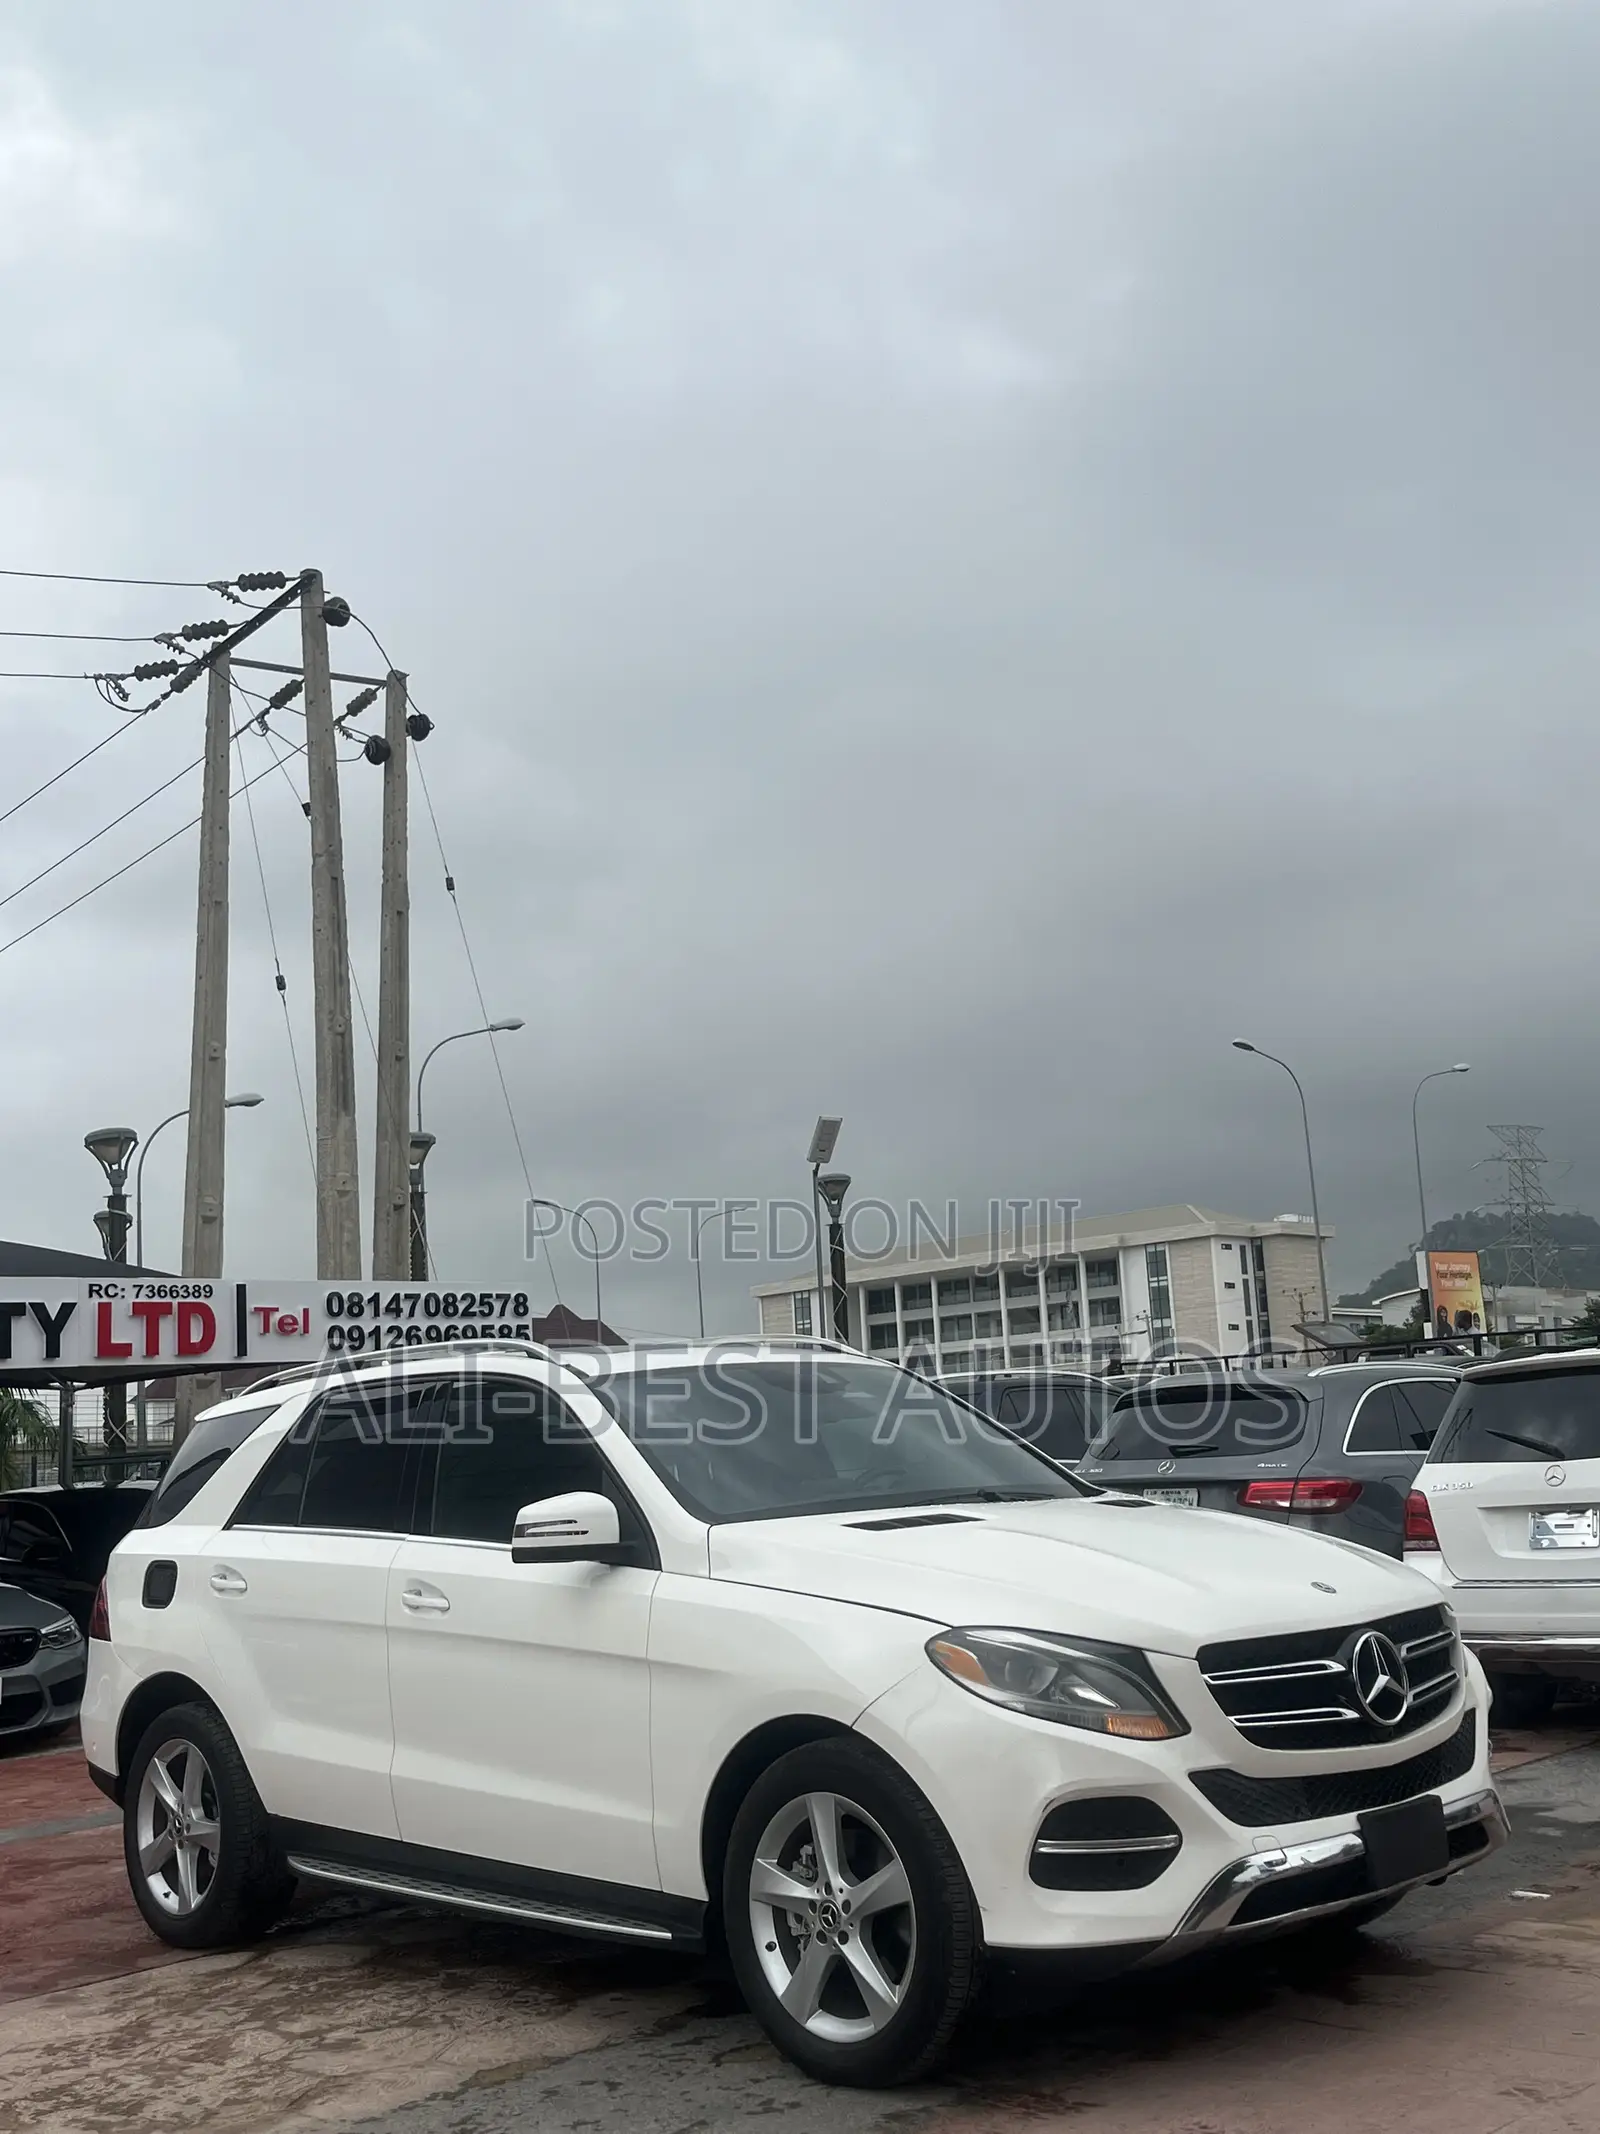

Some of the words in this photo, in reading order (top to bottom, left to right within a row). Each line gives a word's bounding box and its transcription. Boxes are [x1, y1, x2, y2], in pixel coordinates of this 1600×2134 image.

[88, 1284, 126, 1299] RC:
[133, 1284, 213, 1299] 7366389
[326, 1292, 529, 1318] 08147082578
[95, 1302, 217, 1359] LTD
[253, 1307, 309, 1335] Tel
